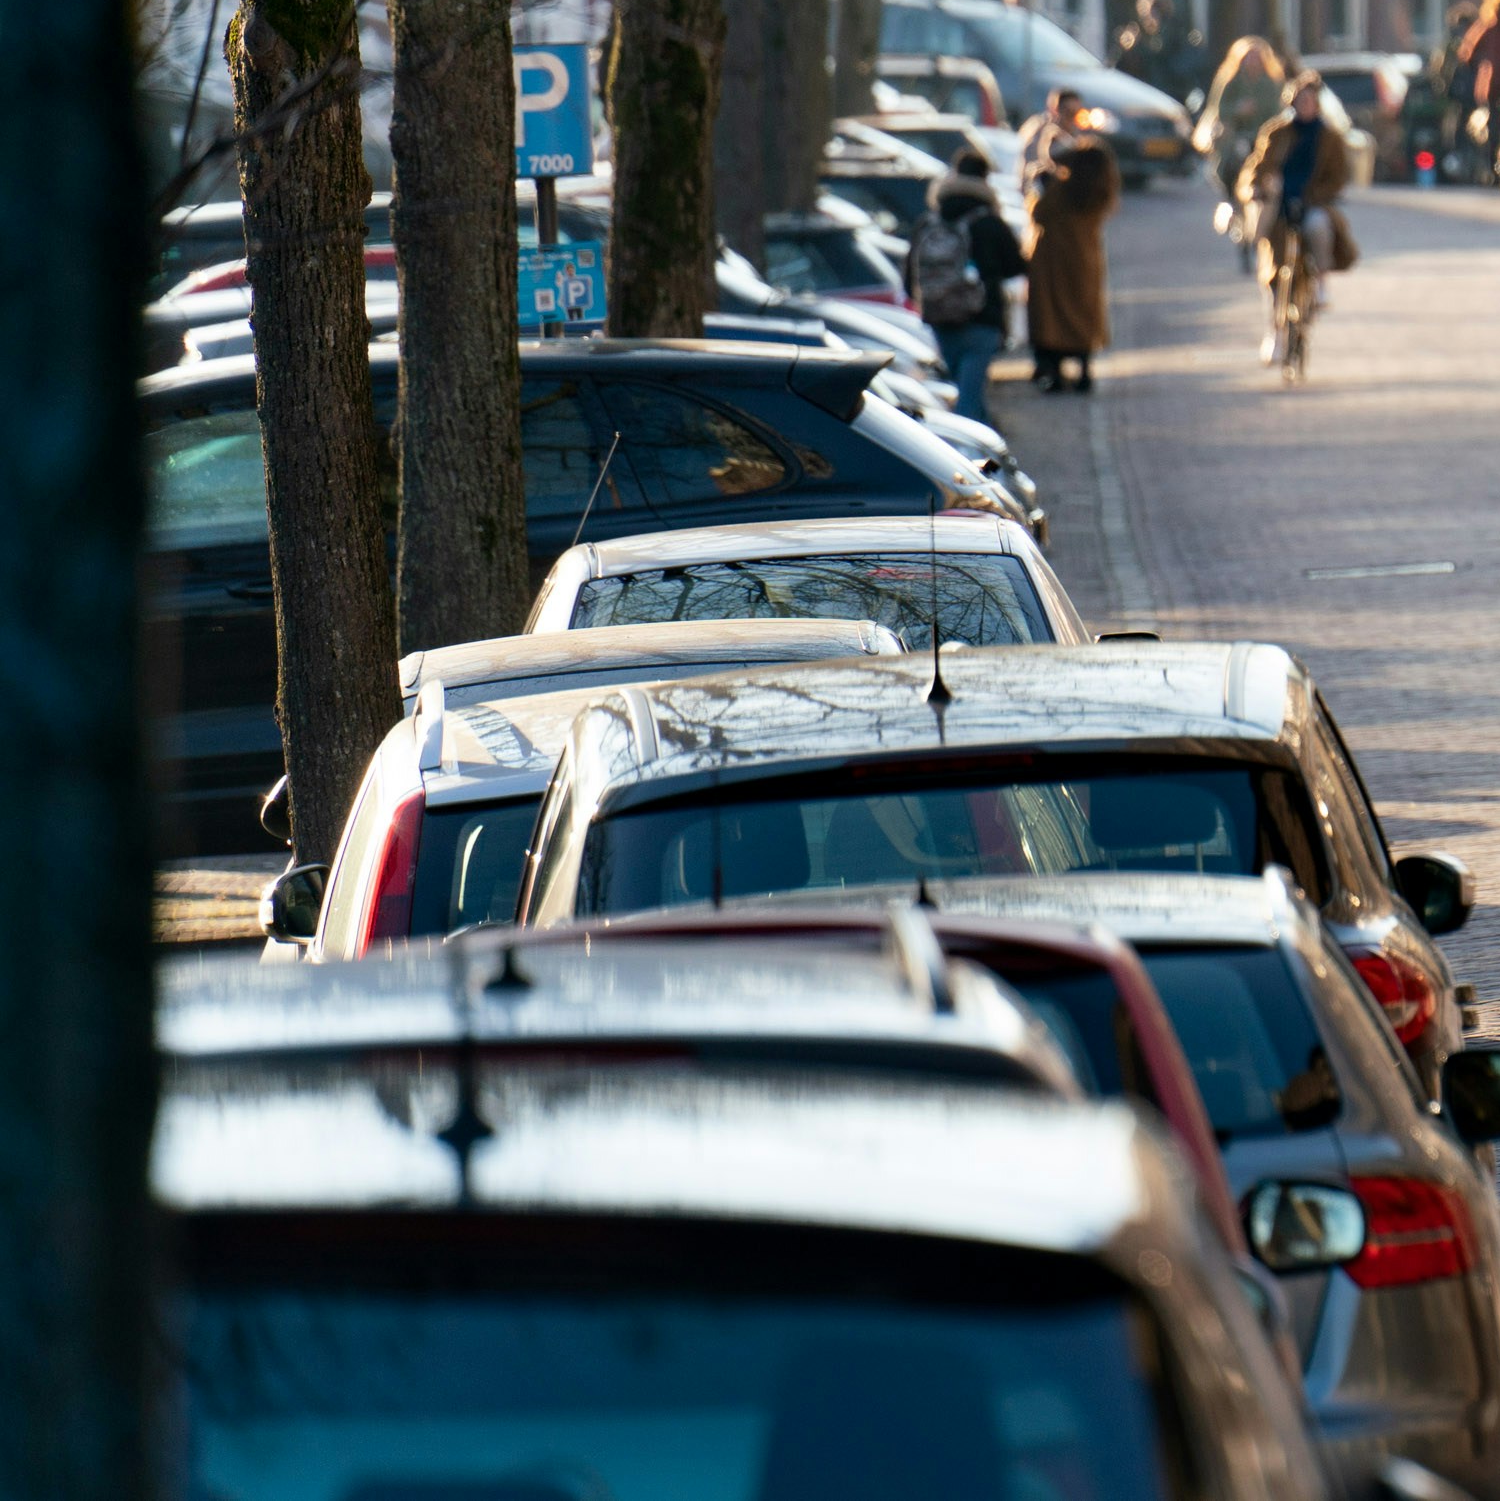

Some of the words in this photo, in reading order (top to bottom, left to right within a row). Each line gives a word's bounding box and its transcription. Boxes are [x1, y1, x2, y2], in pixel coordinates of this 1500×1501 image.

[512, 51, 570, 148] P
[528, 153, 575, 175] 7000
[568, 280, 586, 307] P
